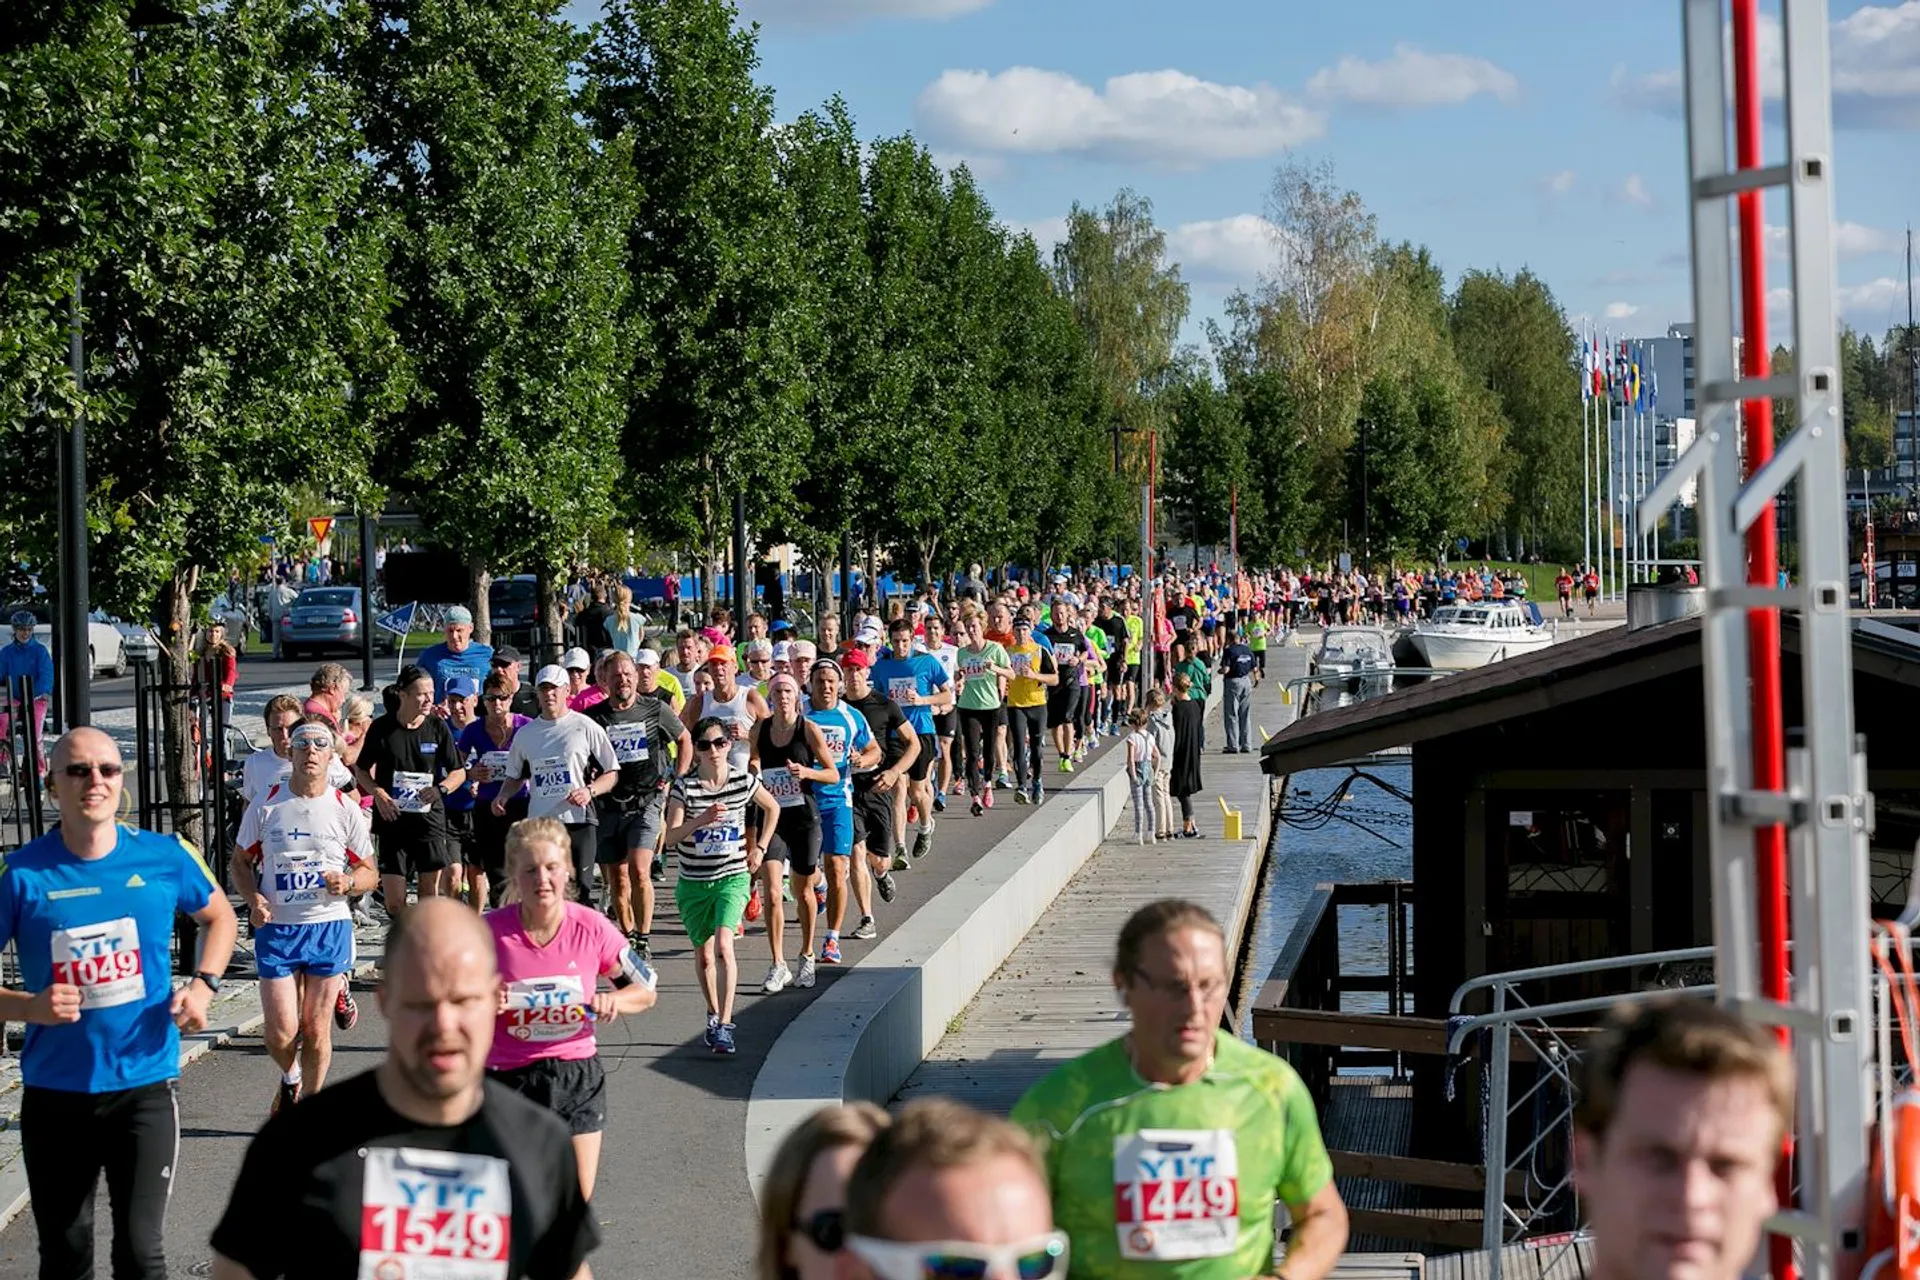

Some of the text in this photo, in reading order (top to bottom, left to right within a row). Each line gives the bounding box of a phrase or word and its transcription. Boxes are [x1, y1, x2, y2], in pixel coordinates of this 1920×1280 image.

[614, 737, 640, 751] 247
[541, 771, 565, 786] 203
[399, 787, 420, 801] 22
[766, 781, 801, 797] 2098
[702, 827, 731, 842] 257
[283, 872, 320, 890] 102
[69, 937, 123, 958] YIT
[60, 951, 138, 985] 1049
[524, 991, 570, 1007] YIT
[513, 1004, 582, 1027] 1266
[1139, 1156, 1215, 1179] YIT
[397, 1178, 484, 1209] YIT
[1122, 1176, 1233, 1222] 1449
[371, 1205, 503, 1259] 1549
